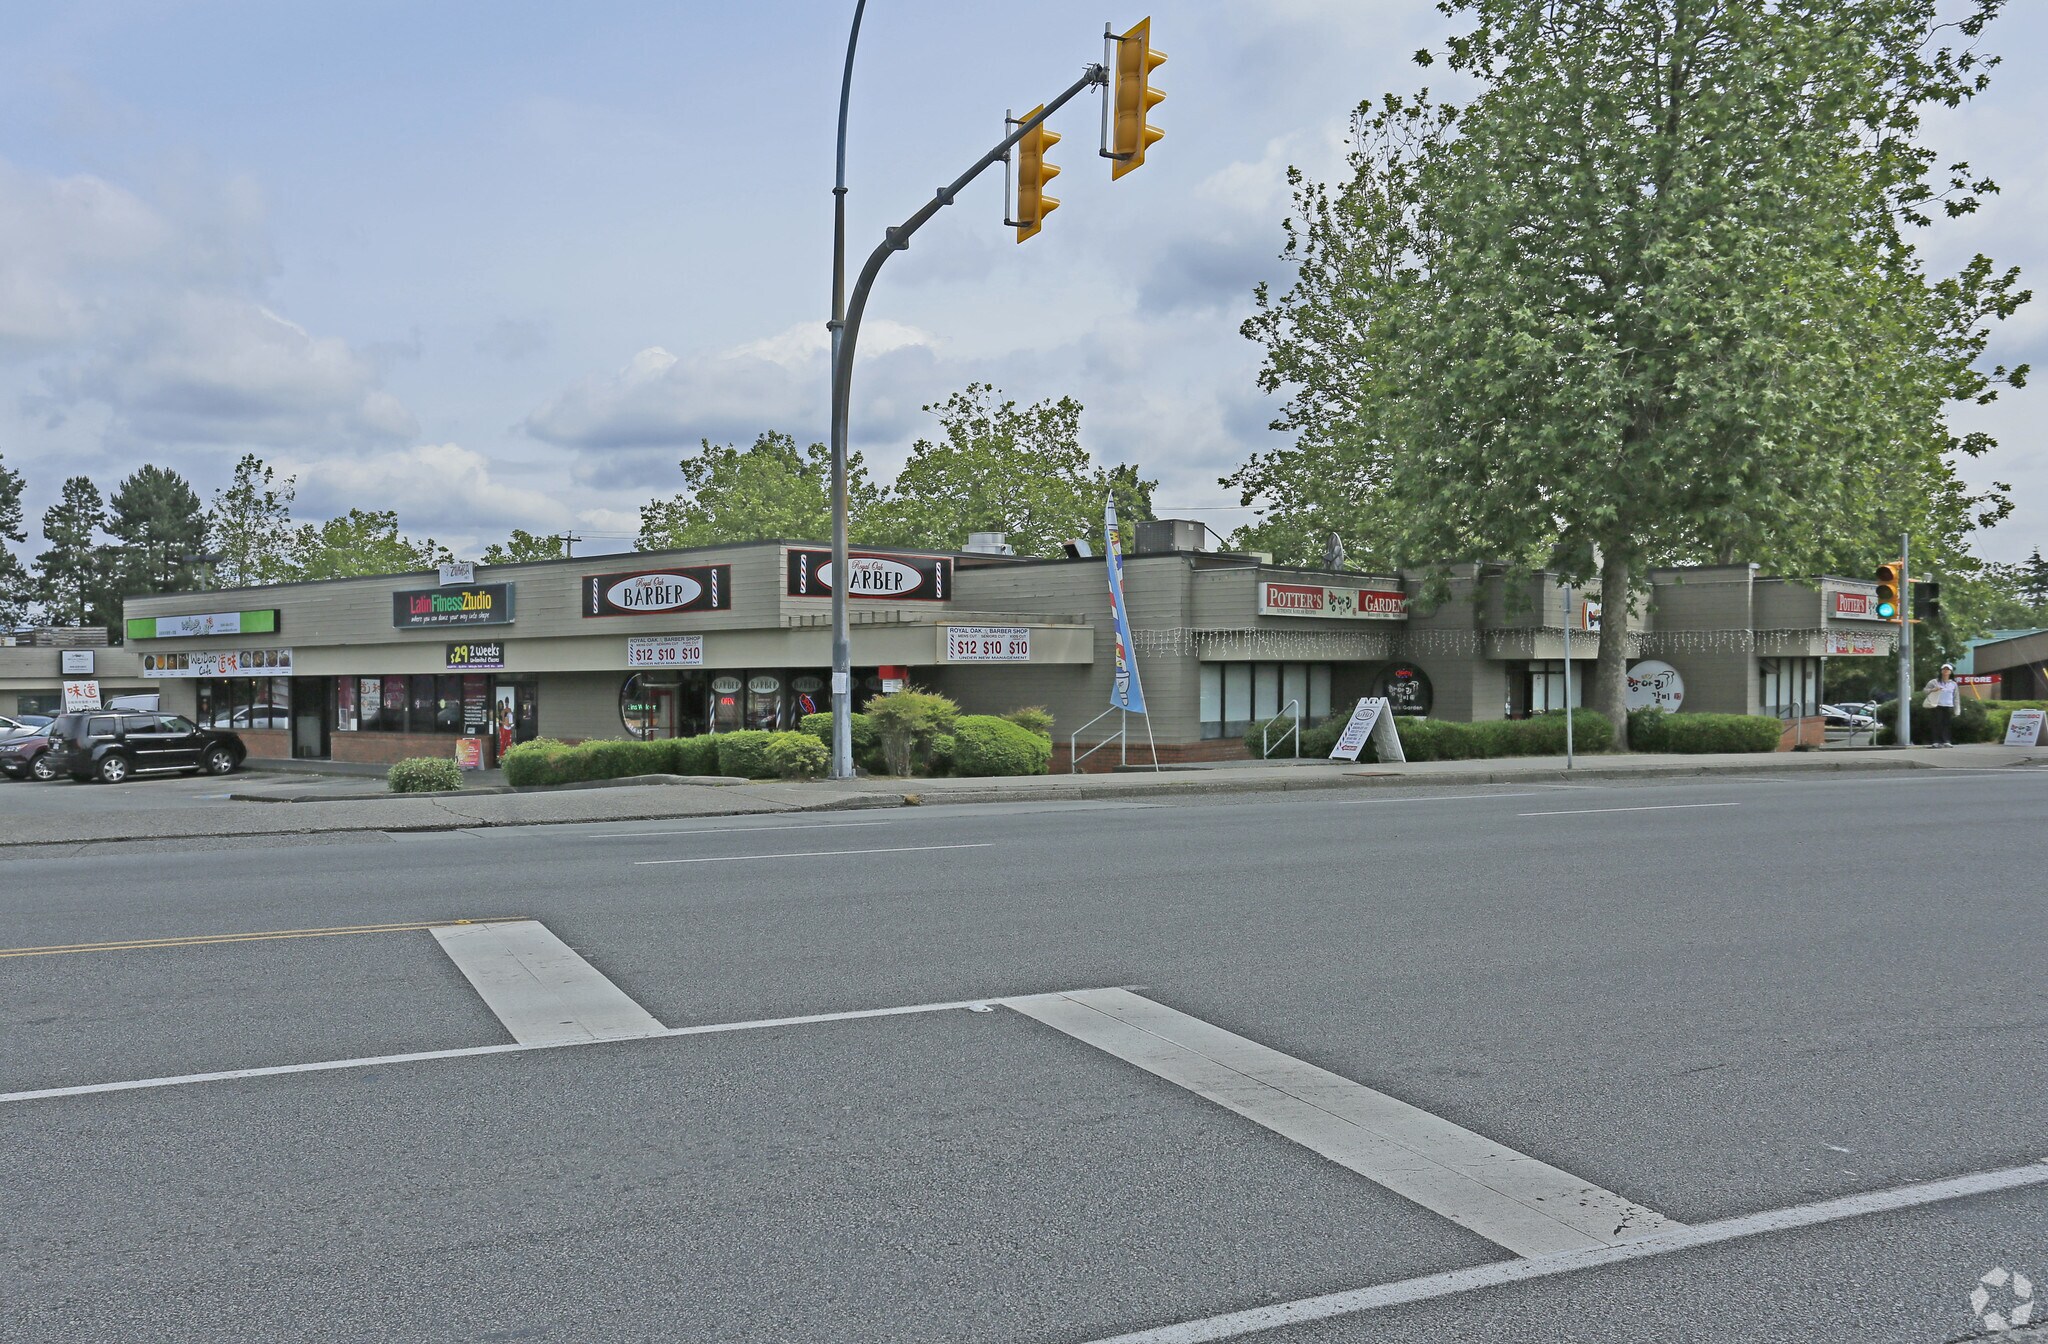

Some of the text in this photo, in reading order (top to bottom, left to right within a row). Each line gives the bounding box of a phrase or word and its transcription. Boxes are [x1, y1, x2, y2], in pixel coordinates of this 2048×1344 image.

[849, 570, 903, 591] ARBER
[624, 585, 683, 606] BARBER
[450, 645, 468, 664] $29
[470, 645, 475, 656] 2
[636, 648, 653, 661] $12
[658, 648, 675, 661] $10
[682, 647, 700, 660] $10
[957, 640, 977, 655] $12
[983, 641, 1002, 655] $10
[1009, 641, 1027, 655] $10
